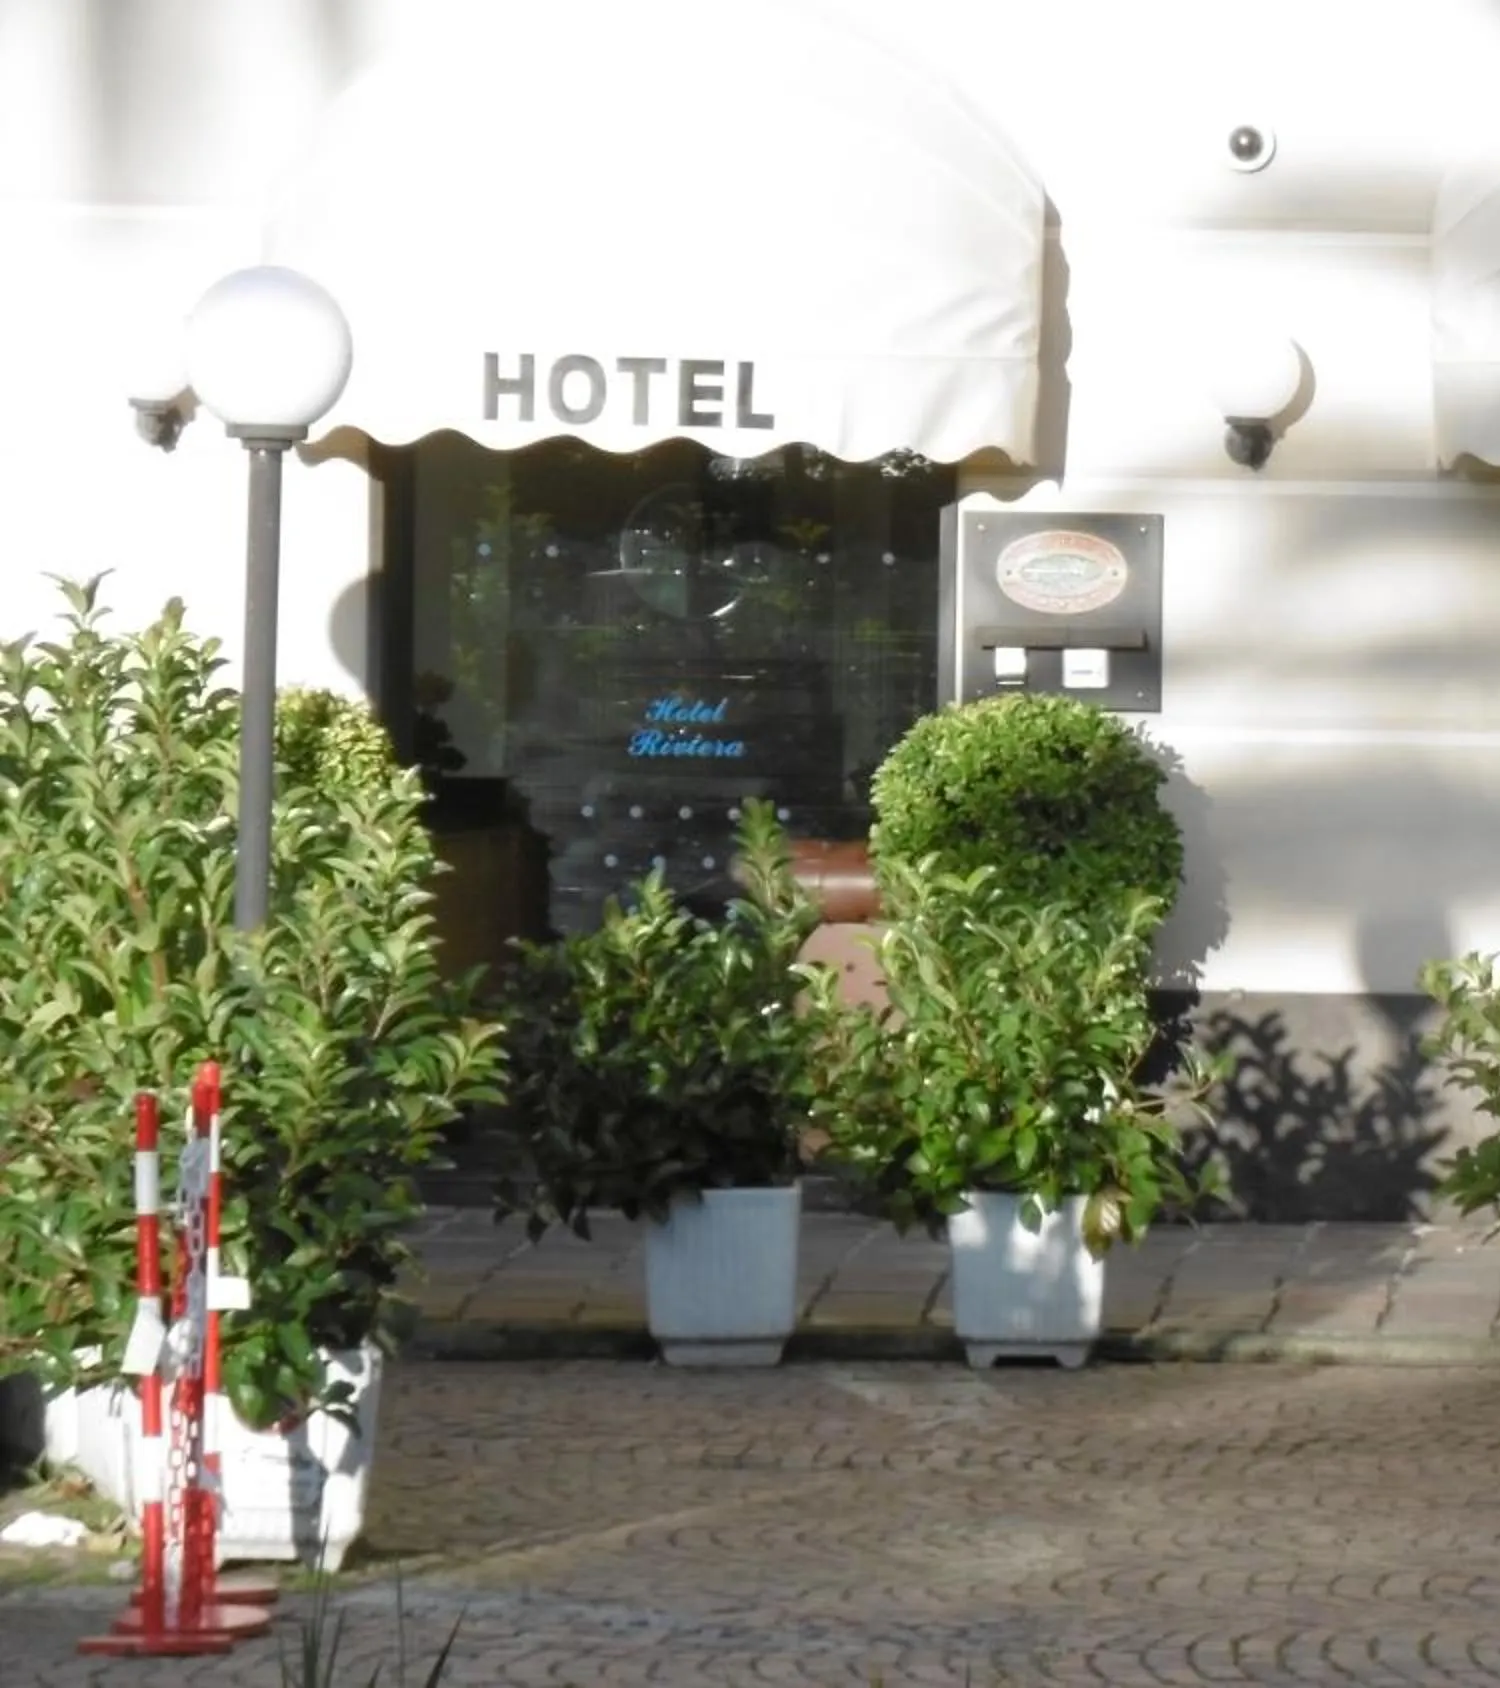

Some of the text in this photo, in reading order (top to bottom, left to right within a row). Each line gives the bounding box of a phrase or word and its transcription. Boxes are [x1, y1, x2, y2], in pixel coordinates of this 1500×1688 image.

[483, 352, 775, 430] HOTEL
[645, 694, 728, 723] Hotel
[628, 730, 746, 757] Riviera
